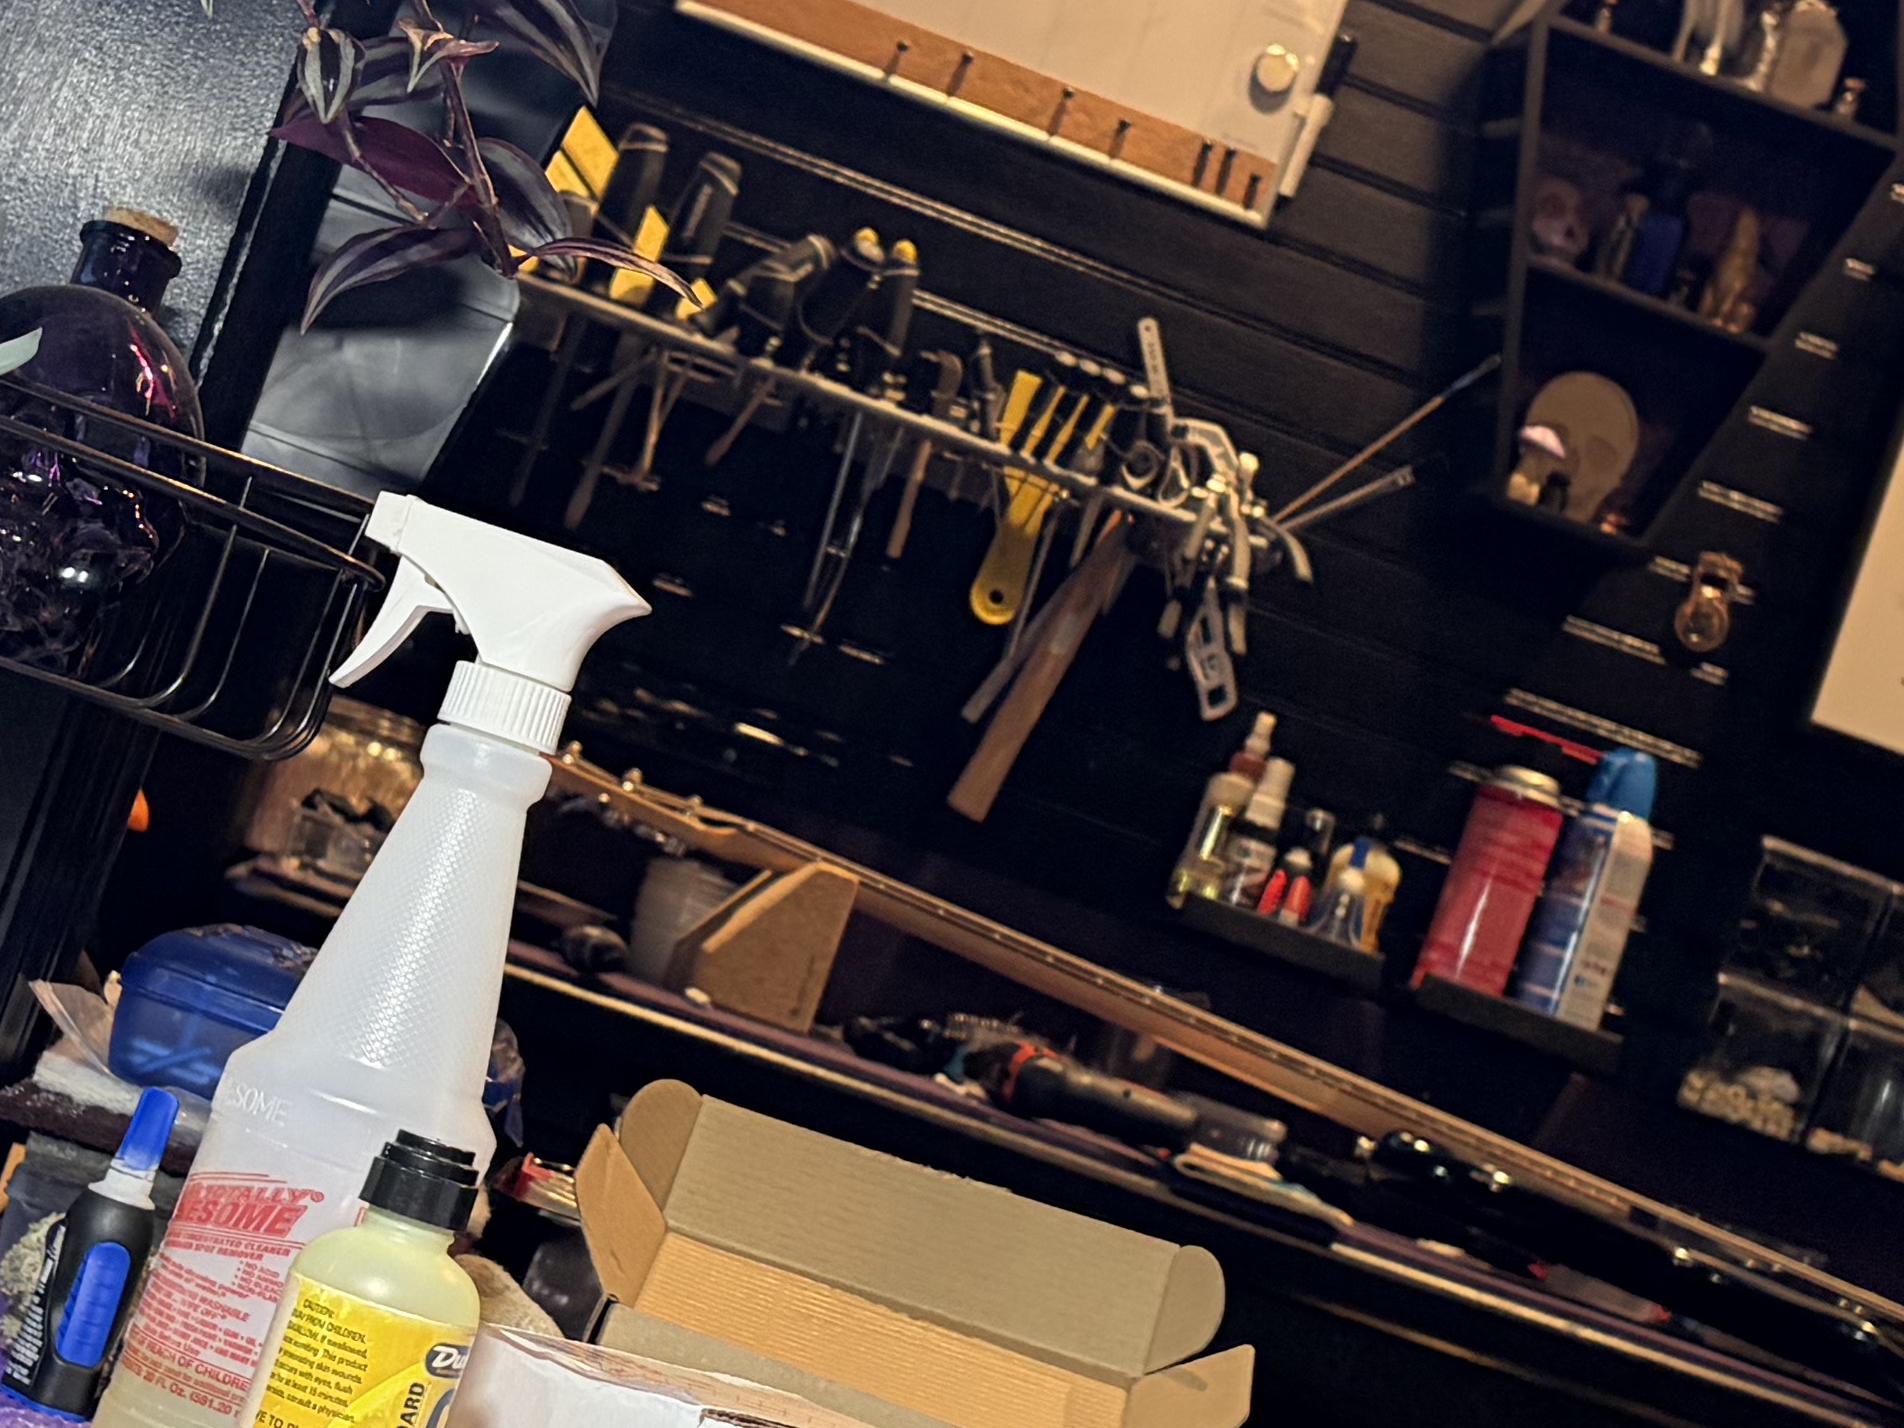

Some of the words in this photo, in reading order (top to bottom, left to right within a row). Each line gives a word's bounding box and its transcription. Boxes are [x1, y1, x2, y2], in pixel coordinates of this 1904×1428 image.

[245, 1241, 292, 1258] CLEANER
[321, 1348, 337, 1361] This
[336, 1355, 368, 1373] product
[176, 1355, 194, 1370] OF
[193, 1362, 251, 1393] CHILDRE
[298, 1368, 313, 1380] with
[333, 1381, 353, 1394] flush
